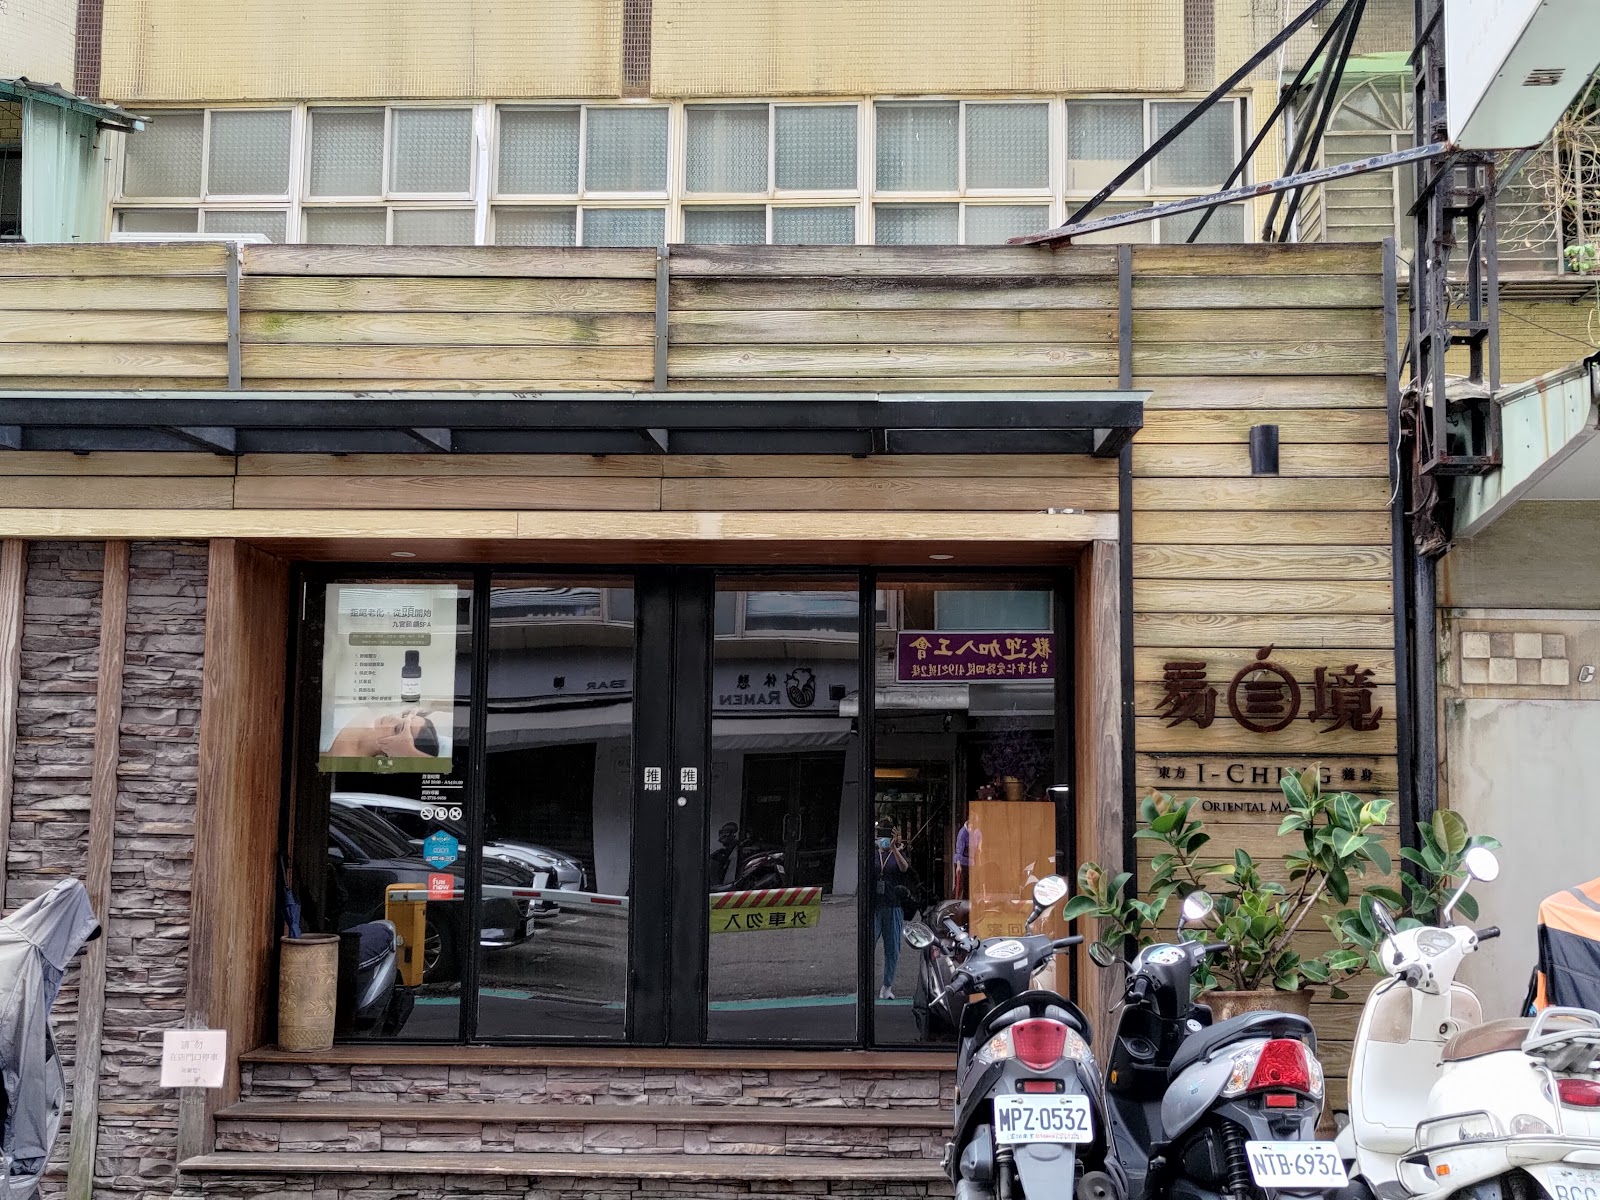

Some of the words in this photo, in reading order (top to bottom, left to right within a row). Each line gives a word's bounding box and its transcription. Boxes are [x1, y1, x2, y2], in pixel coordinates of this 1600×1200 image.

[646, 768, 660, 783] 推
[682, 768, 696, 783] 推
[1157, 765, 1187, 779] 東方
[1201, 800, 1267, 813] ORIENTAL
